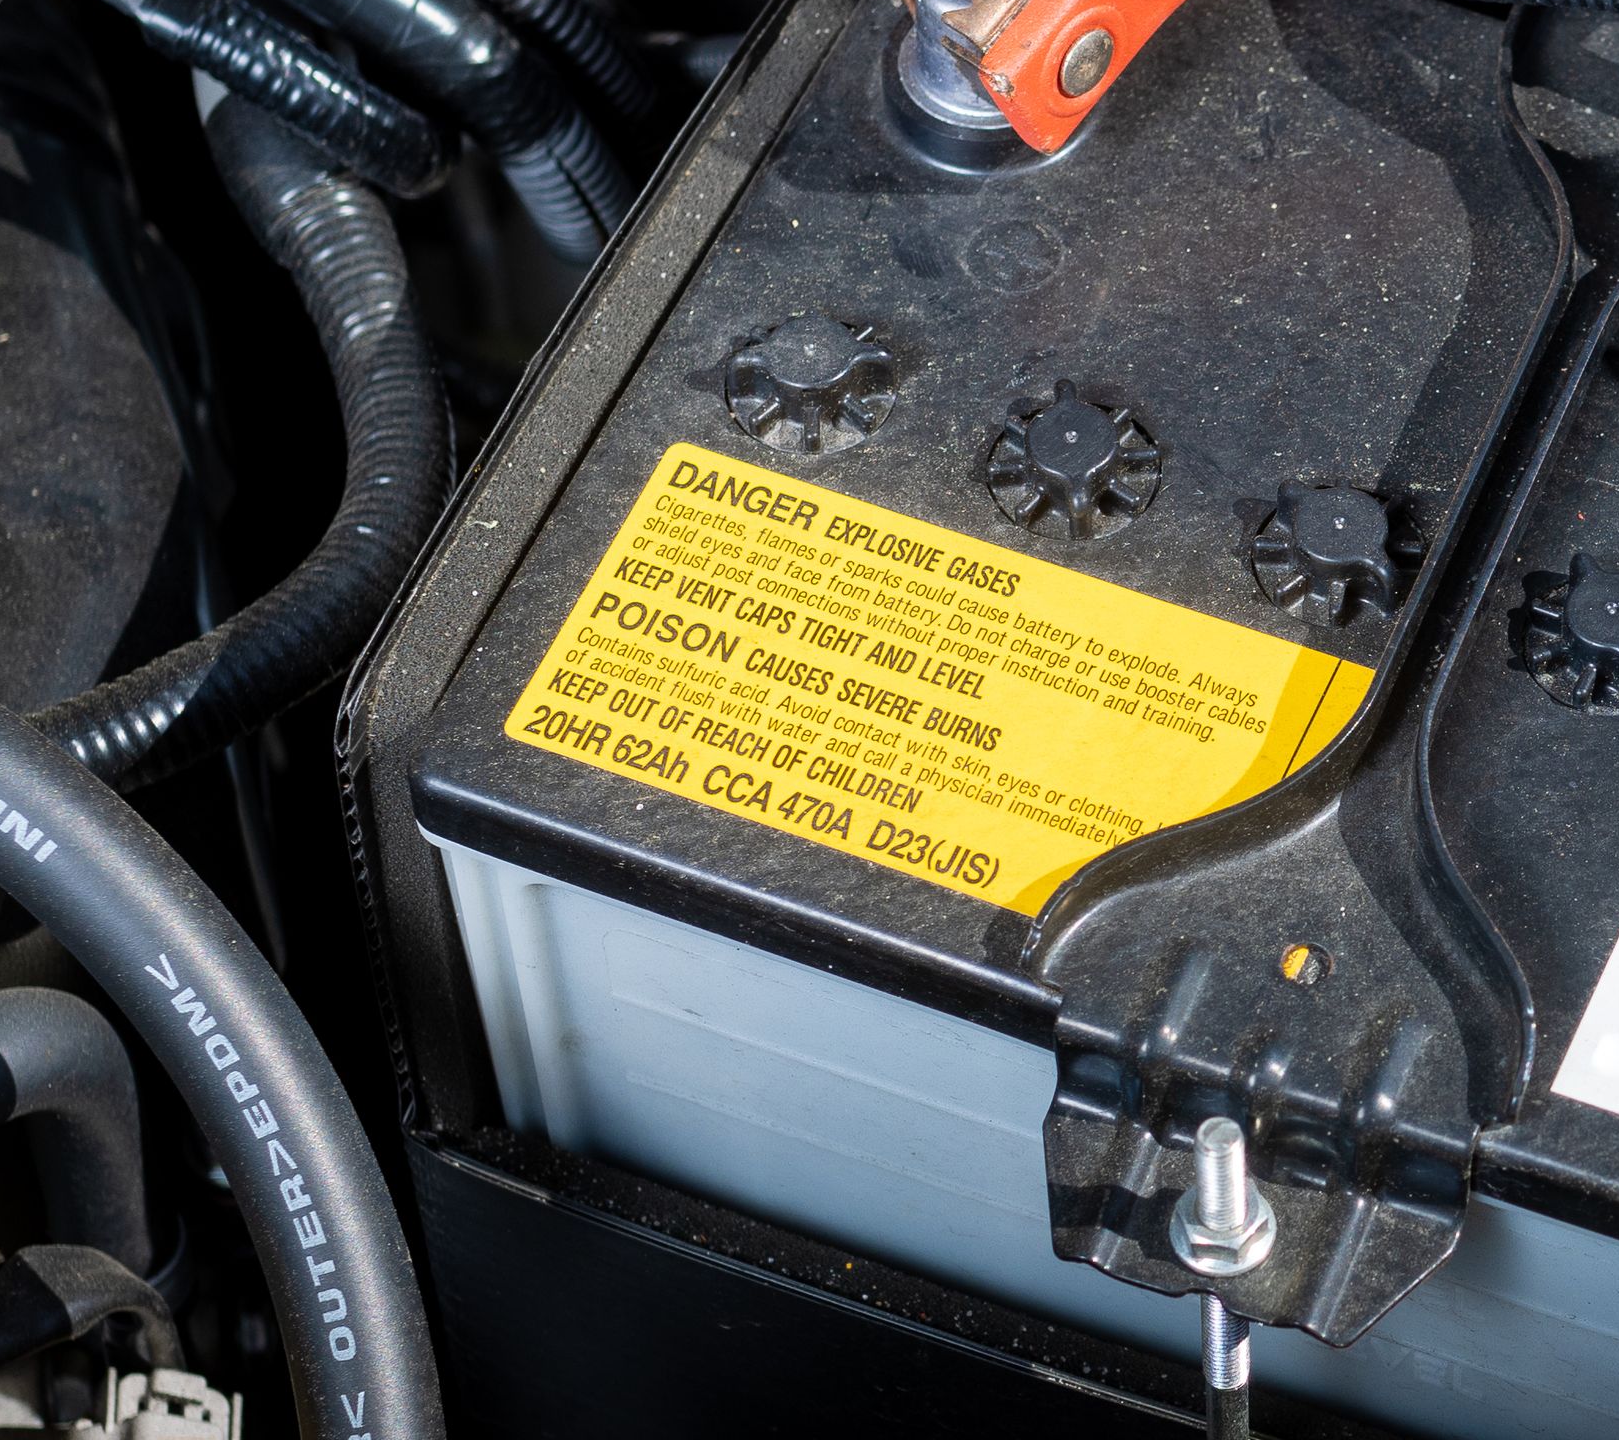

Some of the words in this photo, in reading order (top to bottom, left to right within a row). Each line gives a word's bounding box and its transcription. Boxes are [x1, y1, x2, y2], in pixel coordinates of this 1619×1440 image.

[655, 494, 747, 540] Cigarettes,
[756, 528, 817, 561] flames
[819, 552, 842, 568] or
[843, 560, 903, 589] sparks
[905, 580, 957, 606] could
[958, 598, 1009, 624] cause
[1012, 612, 1082, 651] battery
[1085, 637, 1104, 656] to
[1108, 649, 1179, 682] explode.
[1188, 672, 1258, 708] Always
[668, 460, 820, 532] DANGER
[824, 515, 945, 573] EXPLOSIVE
[946, 556, 1021, 598] GASES
[589, 591, 741, 663] POISON
[745, 648, 834, 696] CAUSES
[836, 678, 923, 725] SEVERE
[922, 706, 1002, 752] BURNS
[613, 556, 675, 591] KEEP
[675, 575, 737, 613] VENT
[735, 596, 797, 635] CAPS
[798, 616, 869, 657] TIGHT
[864, 640, 918, 674] AND
[917, 657, 985, 700] LEVEL
[632, 536, 654, 551] or
[655, 544, 711, 571] adjust
[710, 563, 754, 586] post
[756, 577, 861, 621] connections
[866, 612, 935, 646] without
[935, 637, 999, 666] proper
[1001, 659, 1099, 703] instruction
[1103, 694, 1140, 715] and
[1142, 704, 1215, 743] training.
[643, 516, 699, 544] shield
[700, 536, 743, 559] eyes
[746, 551, 782, 572] and
[784, 560, 822, 586] face
[827, 574, 870, 602] from
[872, 589, 942, 627] battery.
[946, 614, 972, 635] Do
[975, 627, 1007, 648] not
[1010, 638, 1070, 669] charge
[1075, 661, 1097, 677] or
[1099, 669, 1131, 690] use
[1134, 677, 1205, 713] booster
[1208, 705, 1267, 734] cables
[522, 704, 612, 756] 20HR
[612, 734, 690, 784] 62Ah
[702, 764, 773, 813] CCA
[777, 791, 854, 841] 470A
[865, 819, 1000, 889] D23(JIS)
[547, 668, 609, 704] KEEP
[608, 688, 661, 722] OUT
[658, 705, 695, 733] OF
[691, 716, 773, 762] REACH
[772, 744, 808, 772] OF
[806, 756, 923, 813] CHILDREN
[565, 649, 589, 665] of
[589, 657, 666, 693] accident
[669, 681, 715, 709] flush
[720, 701, 762, 726] with
[767, 717, 822, 744] water
[825, 737, 862, 758] and
[863, 750, 898, 770] call
[900, 762, 913, 776] a
[915, 767, 1004, 808] physician
[577, 626, 655, 665] Contains
[656, 657, 727, 690] sulfuric
[729, 681, 771, 704] acid.
[776, 695, 832, 725] Avoid
[833, 716, 901, 748] contact
[906, 740, 948, 764] with
[951, 755, 991, 782] skin,
[997, 773, 1041, 798] eyes
[1044, 790, 1066, 806] or
[1068, 797, 1143, 836] clothing.
[145, 951, 358, 1362] OUTER>EPDM<
